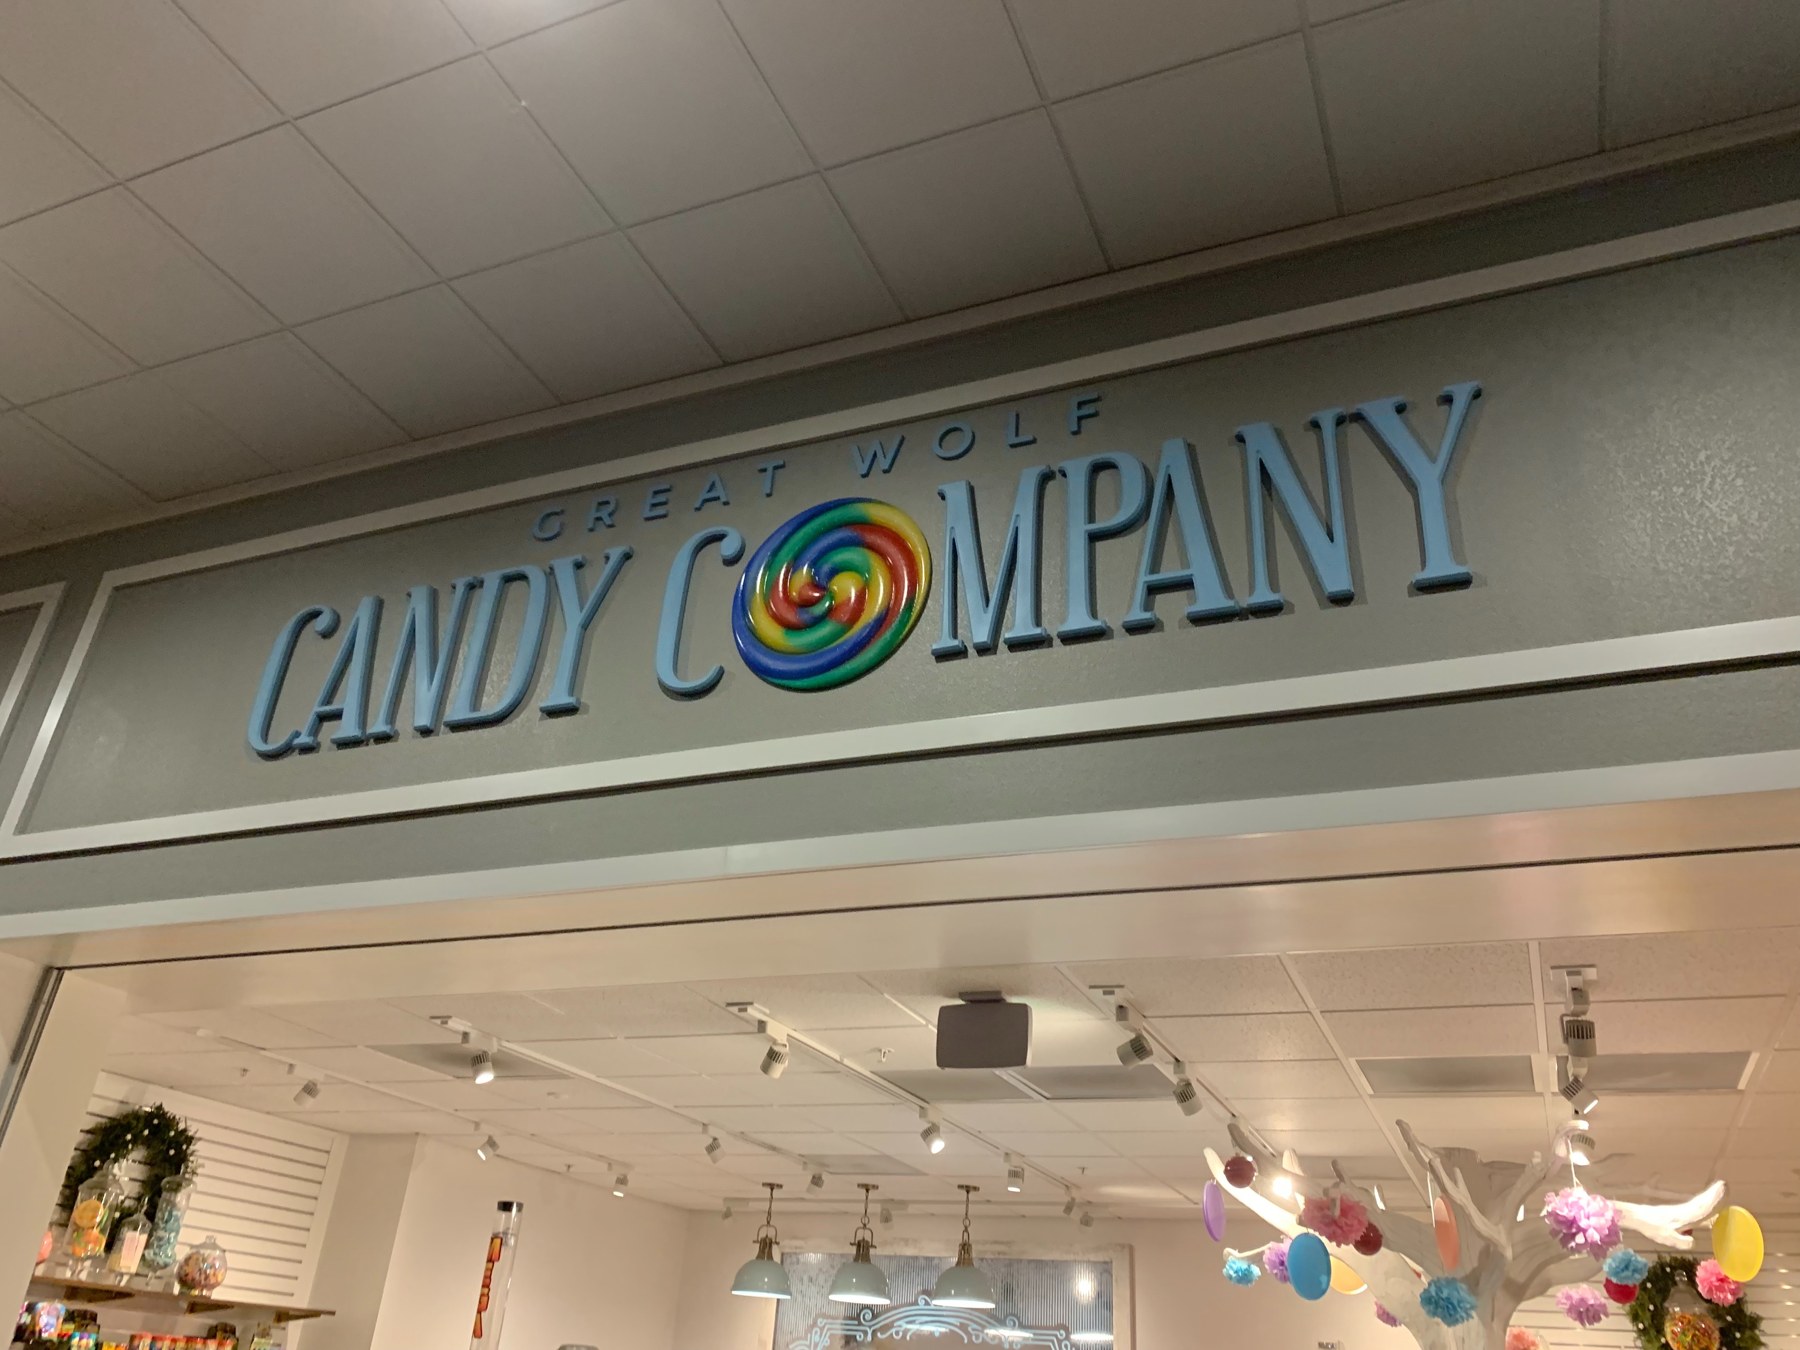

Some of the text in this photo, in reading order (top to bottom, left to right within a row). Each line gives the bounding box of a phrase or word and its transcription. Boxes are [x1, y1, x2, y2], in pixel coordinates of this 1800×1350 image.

[531, 395, 1101, 541] GREAT WOLF
[247, 545, 635, 760] CANDY
